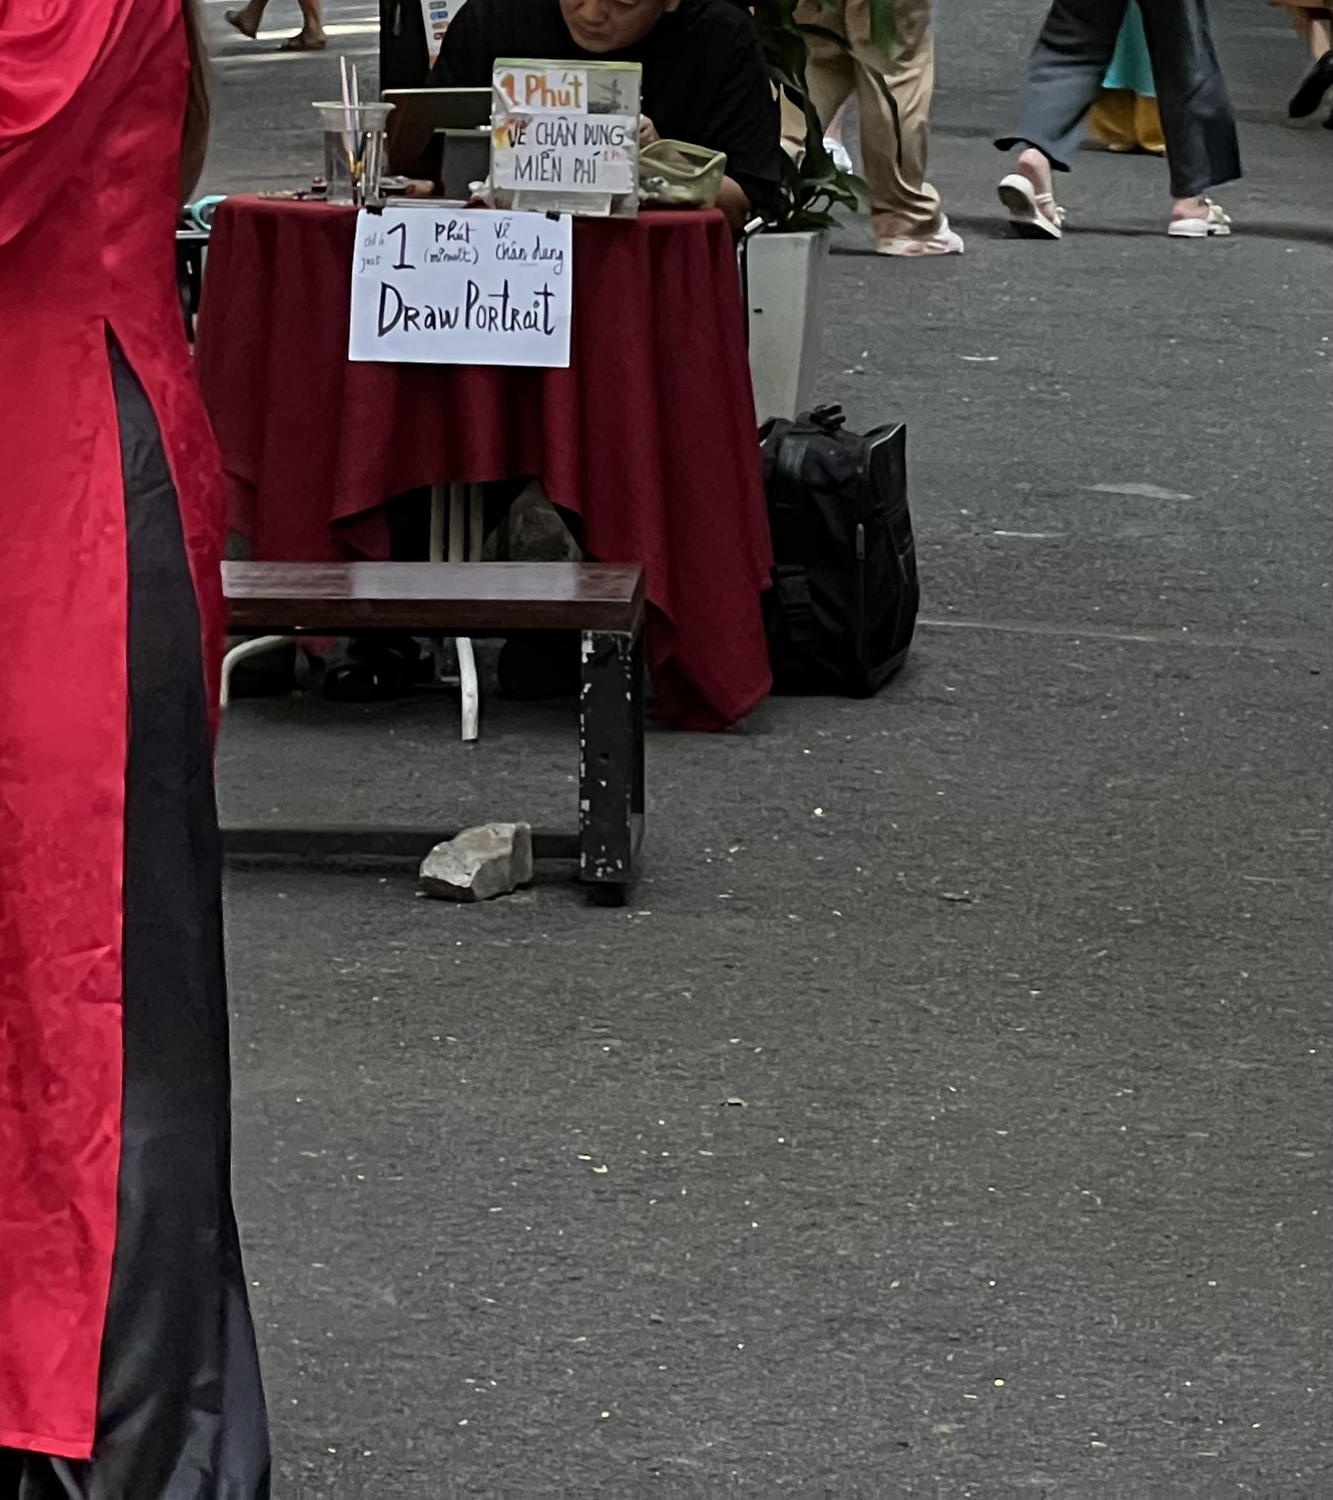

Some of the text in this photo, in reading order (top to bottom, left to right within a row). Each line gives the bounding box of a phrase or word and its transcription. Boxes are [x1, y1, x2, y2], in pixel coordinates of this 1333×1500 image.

[524, 72, 583, 109] Phút
[535, 116, 578, 147] CHÂN
[583, 122, 625, 147] DUNG
[514, 149, 601, 184] MIỄN PHÍ
[386, 221, 417, 270] 1
